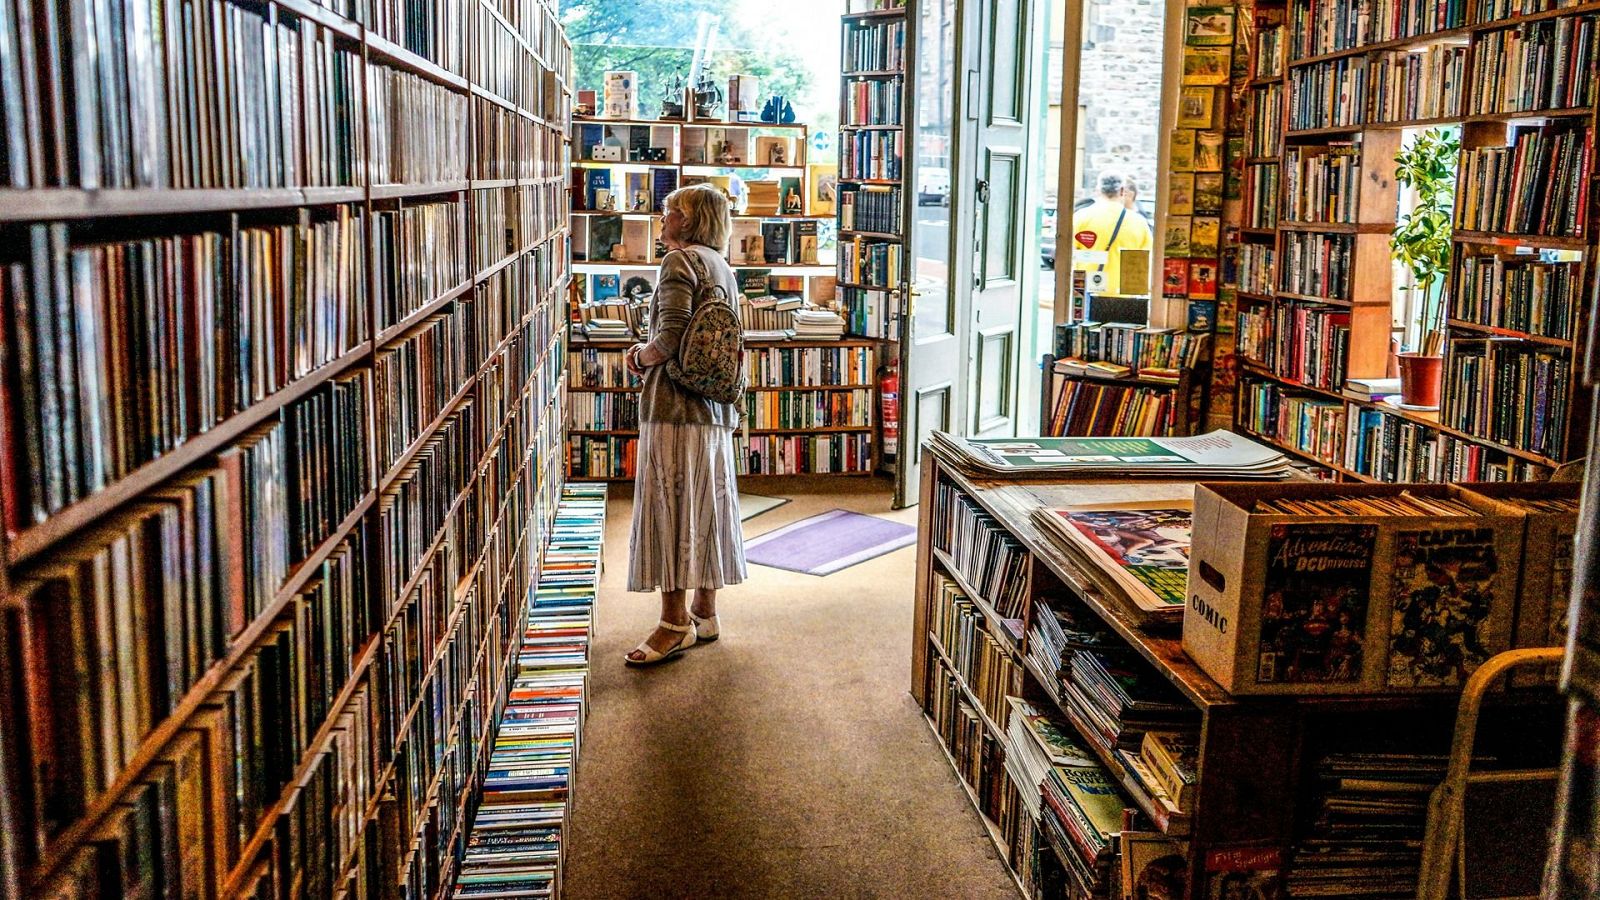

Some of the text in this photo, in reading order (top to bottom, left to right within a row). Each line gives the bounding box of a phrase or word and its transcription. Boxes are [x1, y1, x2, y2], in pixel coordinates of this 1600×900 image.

[1192, 594, 1228, 634] COMIC
[1062, 768, 1103, 778] ROBE
[1067, 776, 1108, 785] SILVE
